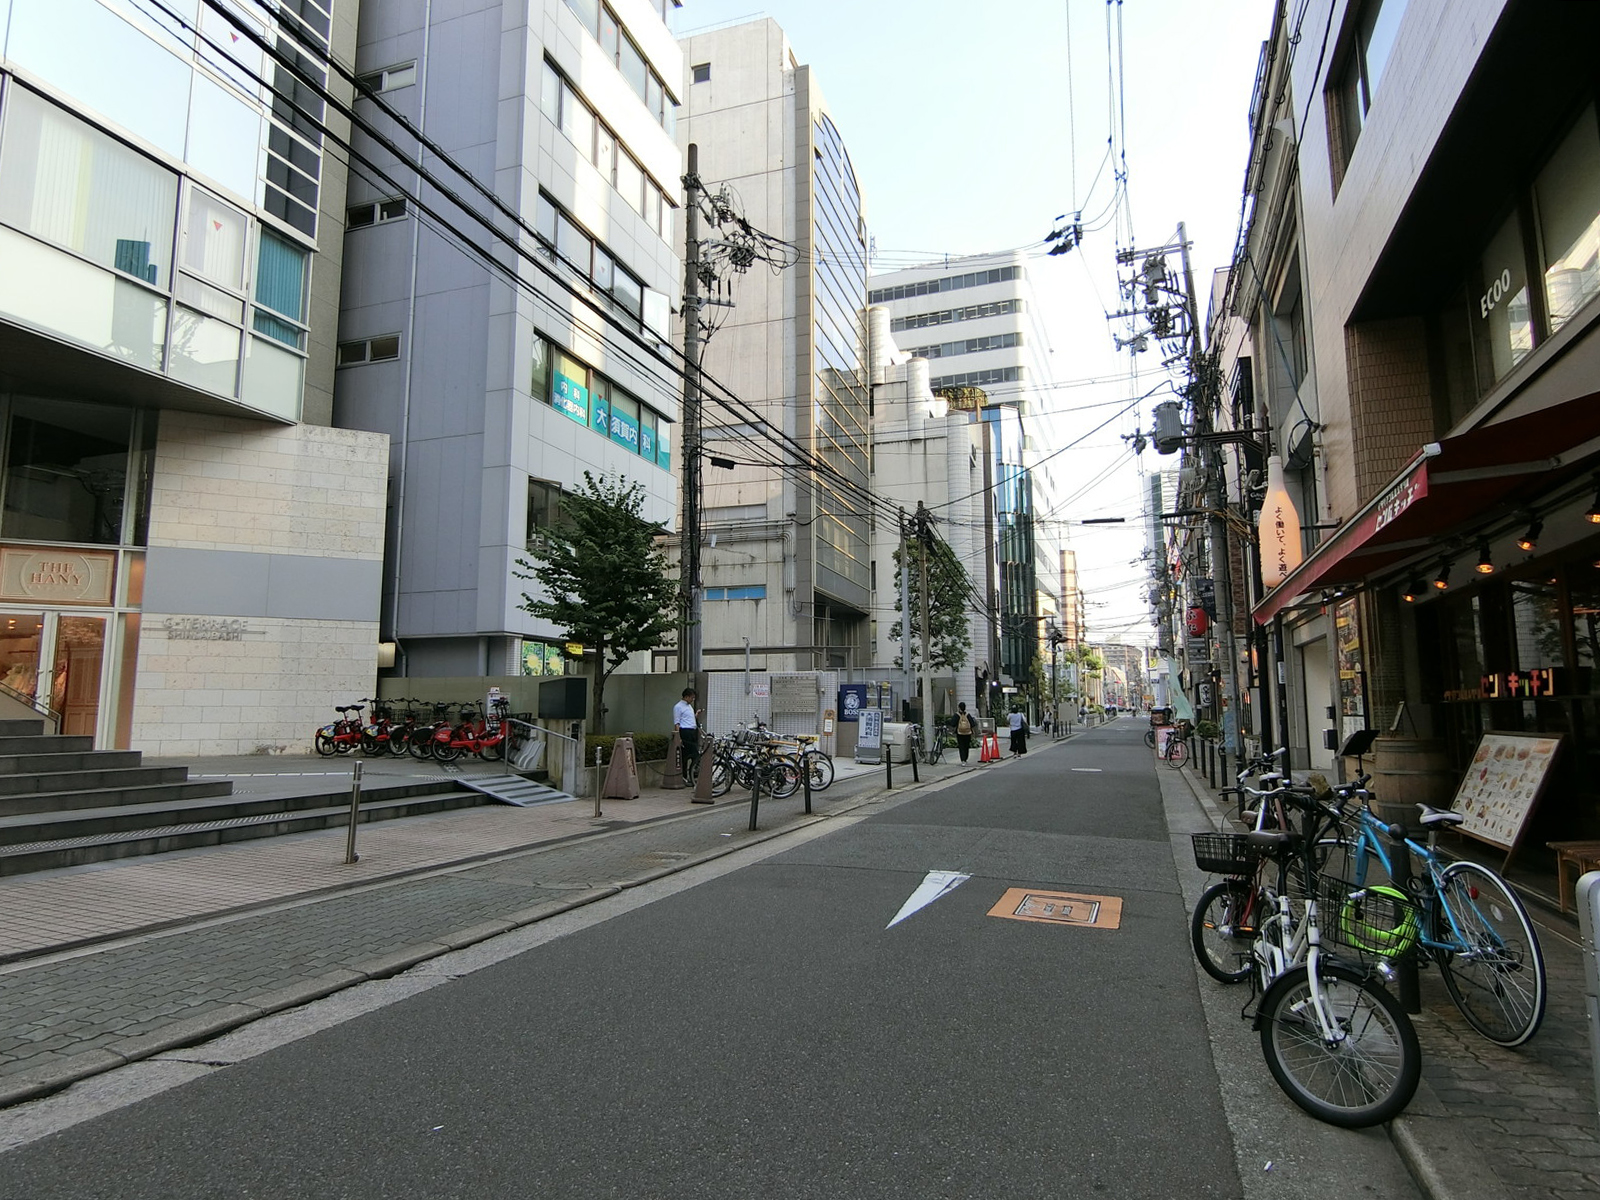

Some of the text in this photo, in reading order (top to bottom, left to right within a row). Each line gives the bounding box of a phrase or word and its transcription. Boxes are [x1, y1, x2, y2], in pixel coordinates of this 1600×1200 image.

[1480, 268, 1511, 319] ECOO
[39, 561, 75, 573] THE
[30, 572, 83, 586] HANY
[162, 617, 249, 631] G-TERRACE
